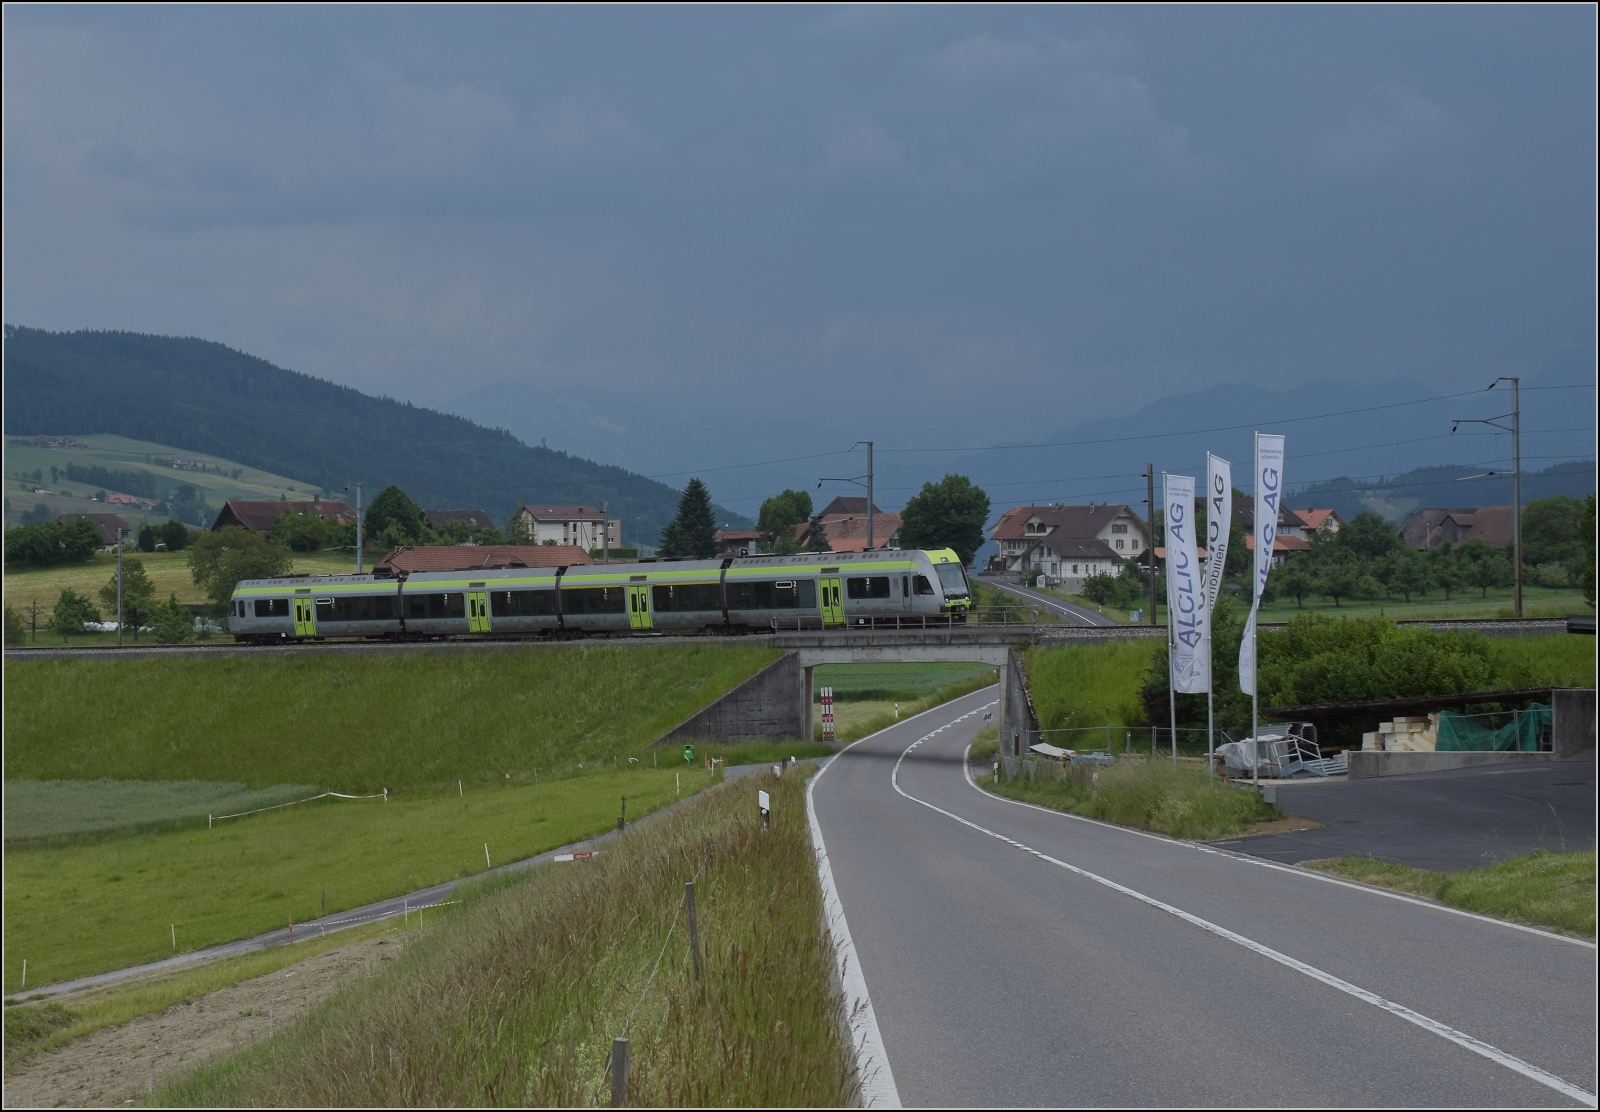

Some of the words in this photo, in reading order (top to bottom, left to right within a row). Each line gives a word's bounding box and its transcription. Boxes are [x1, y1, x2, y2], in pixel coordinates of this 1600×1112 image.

[1213, 473, 1224, 516] AG
[1262, 467, 1278, 515] AG
[1169, 502, 1185, 544] AG
[1174, 550, 1196, 649] ALCLIC
